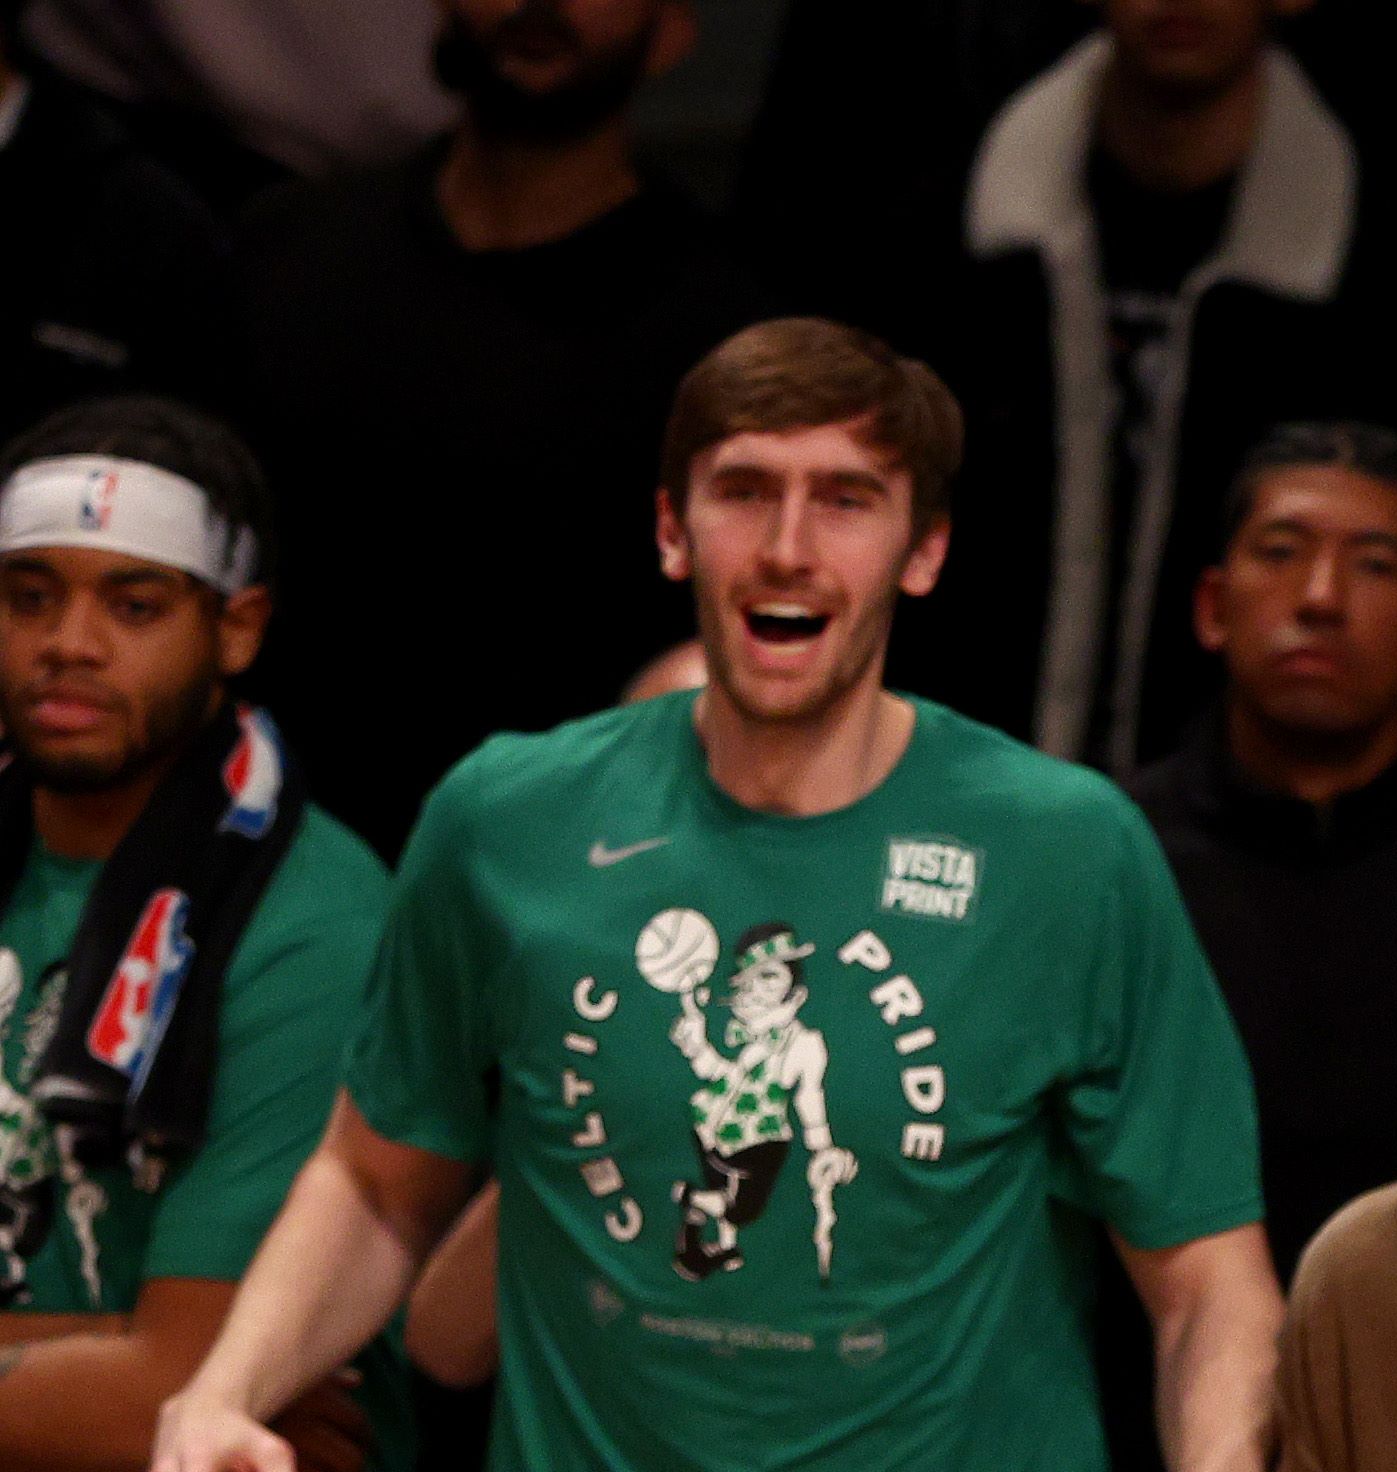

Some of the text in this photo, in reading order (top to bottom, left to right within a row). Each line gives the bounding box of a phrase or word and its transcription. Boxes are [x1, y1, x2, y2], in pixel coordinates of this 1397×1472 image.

[889, 842, 976, 887] VISTA
[882, 878, 969, 920] PRINT
[838, 929, 947, 1162] PRIDE
